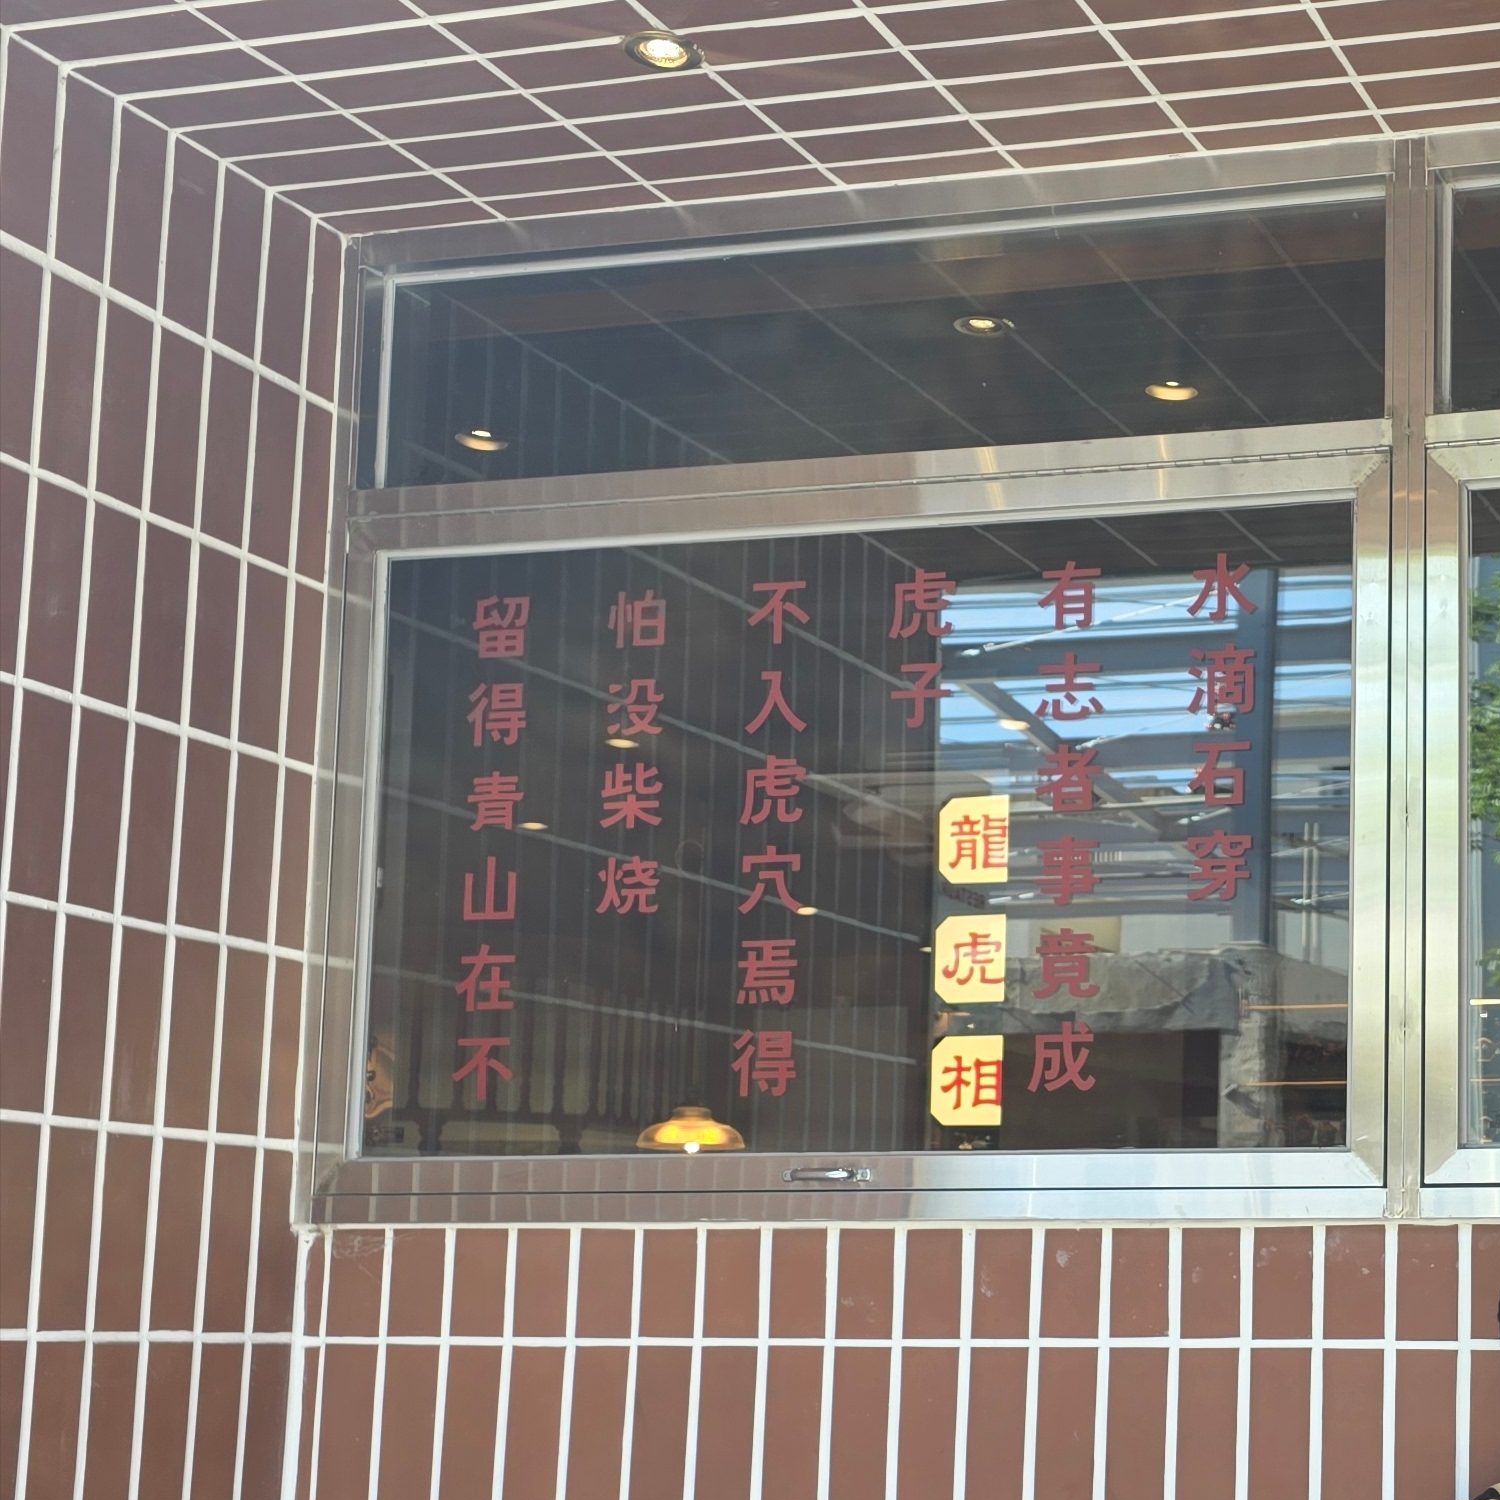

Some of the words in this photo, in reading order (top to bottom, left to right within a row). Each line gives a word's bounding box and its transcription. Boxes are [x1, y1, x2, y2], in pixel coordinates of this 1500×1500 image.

[452, 594, 530, 1100] 留得青山在不
[595, 589, 667, 915] 怕没柴烧
[731, 579, 811, 1097] 不入虎穴焉得
[888, 567, 957, 729] 虎子
[1027, 559, 1104, 1093] 有志者事竟成
[1186, 552, 1259, 902] 水滴石穿
